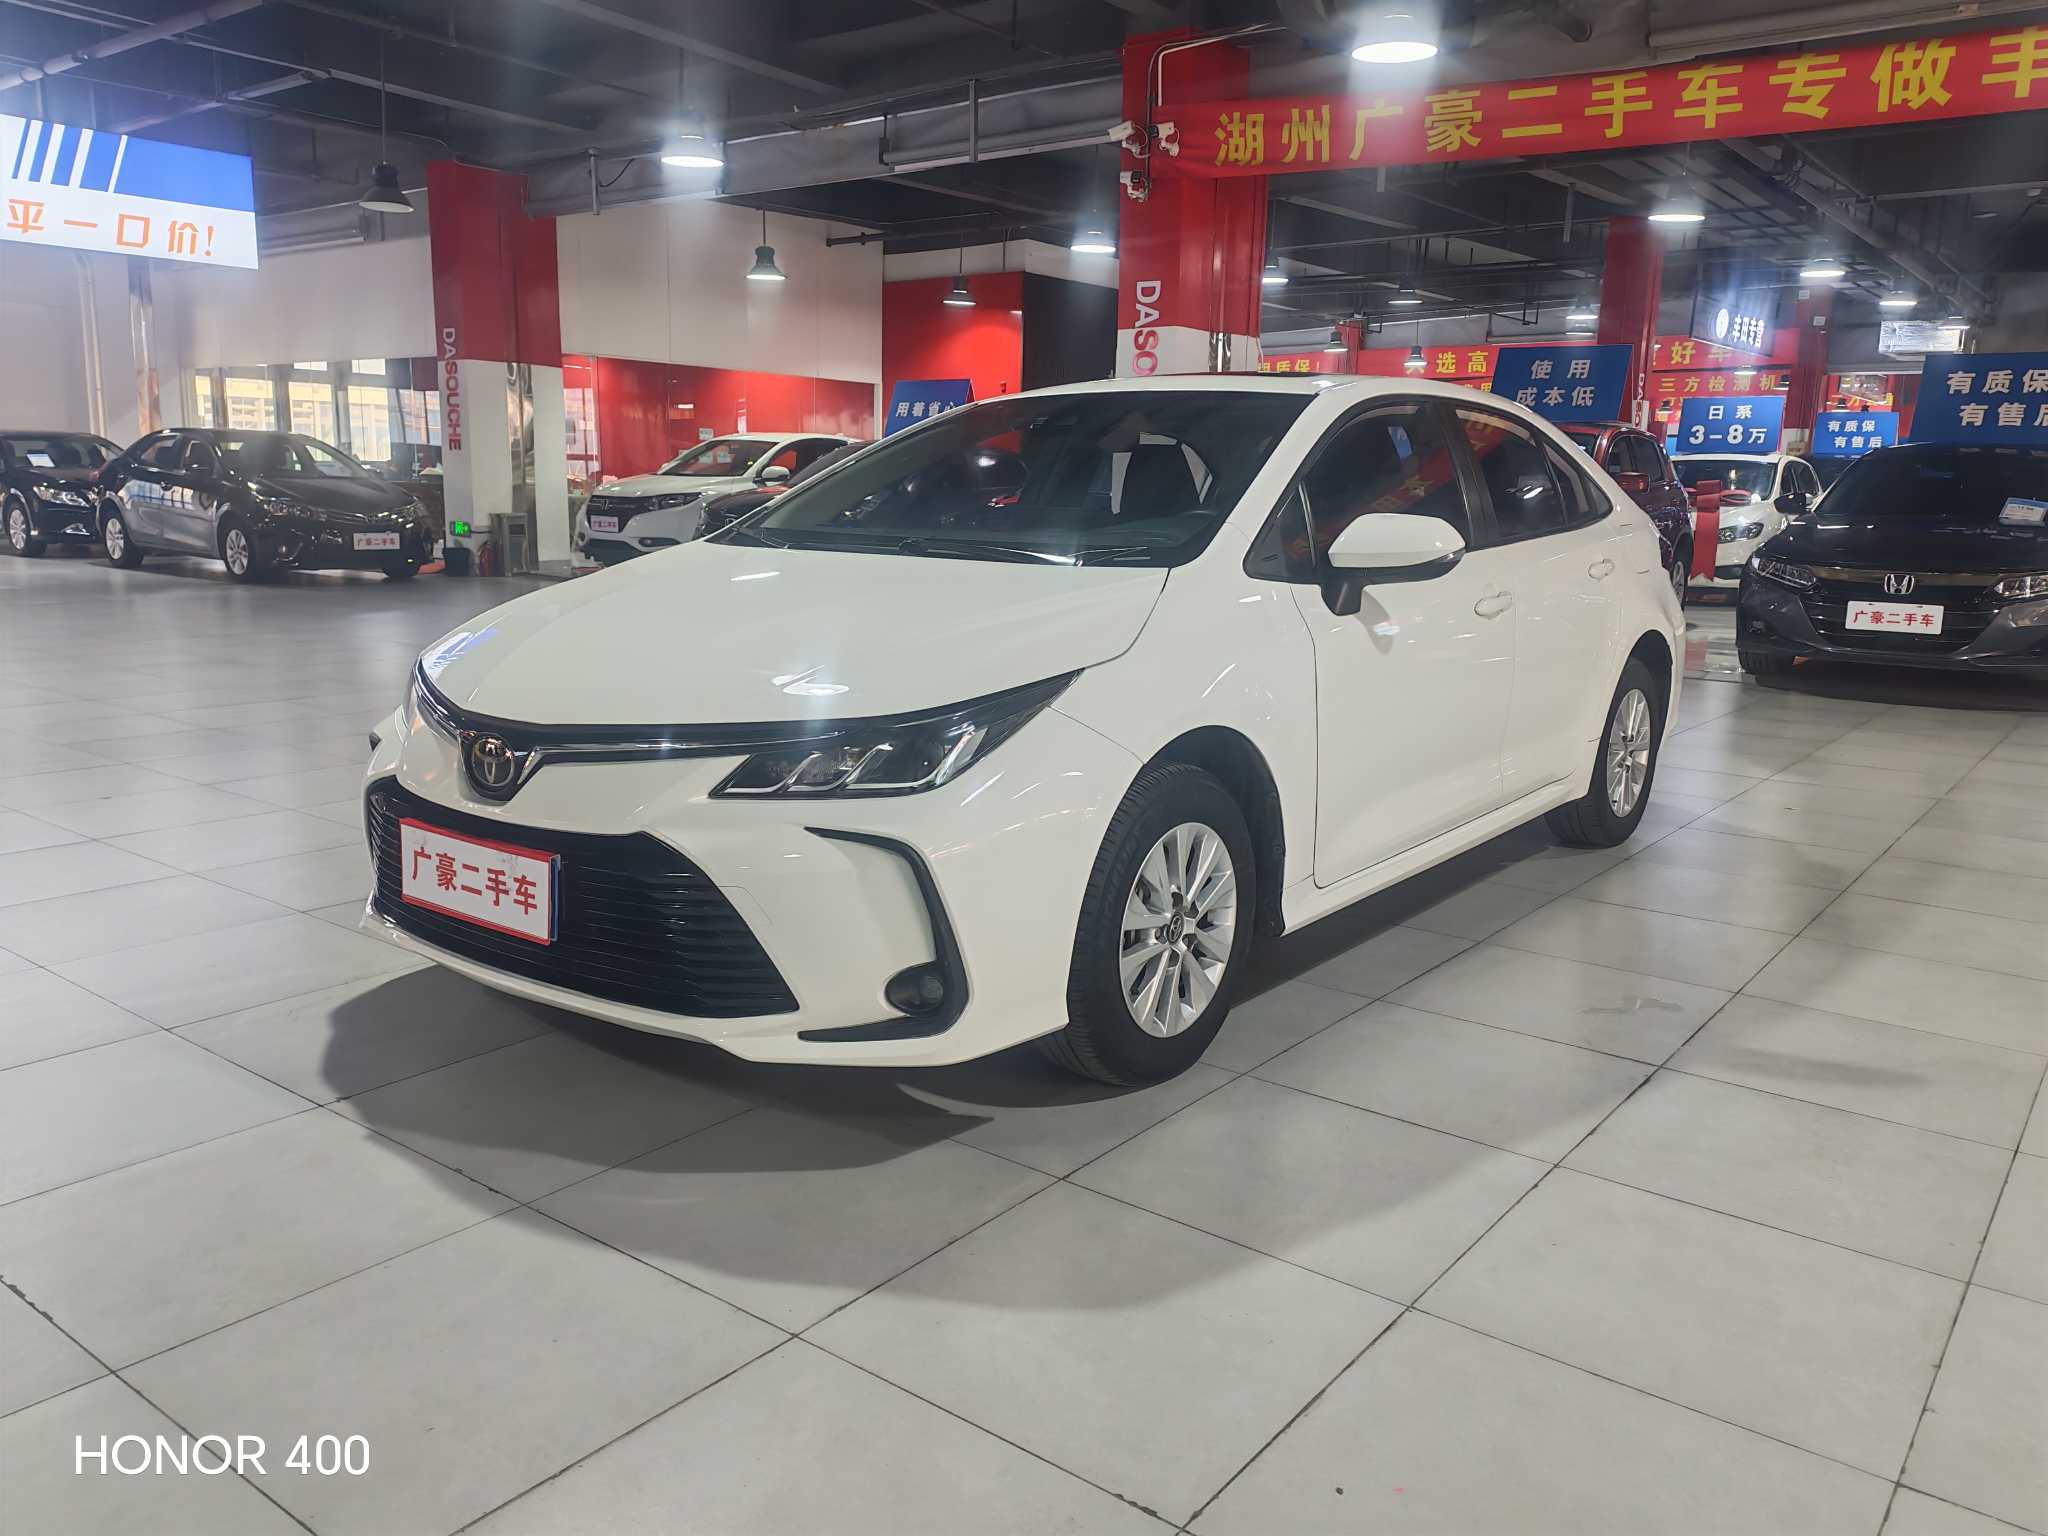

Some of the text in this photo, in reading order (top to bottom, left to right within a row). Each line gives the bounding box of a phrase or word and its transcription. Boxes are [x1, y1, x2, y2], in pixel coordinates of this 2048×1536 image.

[1530, 359, 1591, 380] 使用
[443, 327, 462, 451] DASOUCHE
[1946, 369, 2048, 395] 有质保
[1516, 386, 1595, 407] 成本低
[1708, 405, 1752, 420] 日系
[1827, 420, 1877, 433] 有质保
[1834, 436, 1883, 449] 有售后
[1852, 609, 1935, 629] 广豪二手车
[411, 846, 538, 915] 广豪二手车
